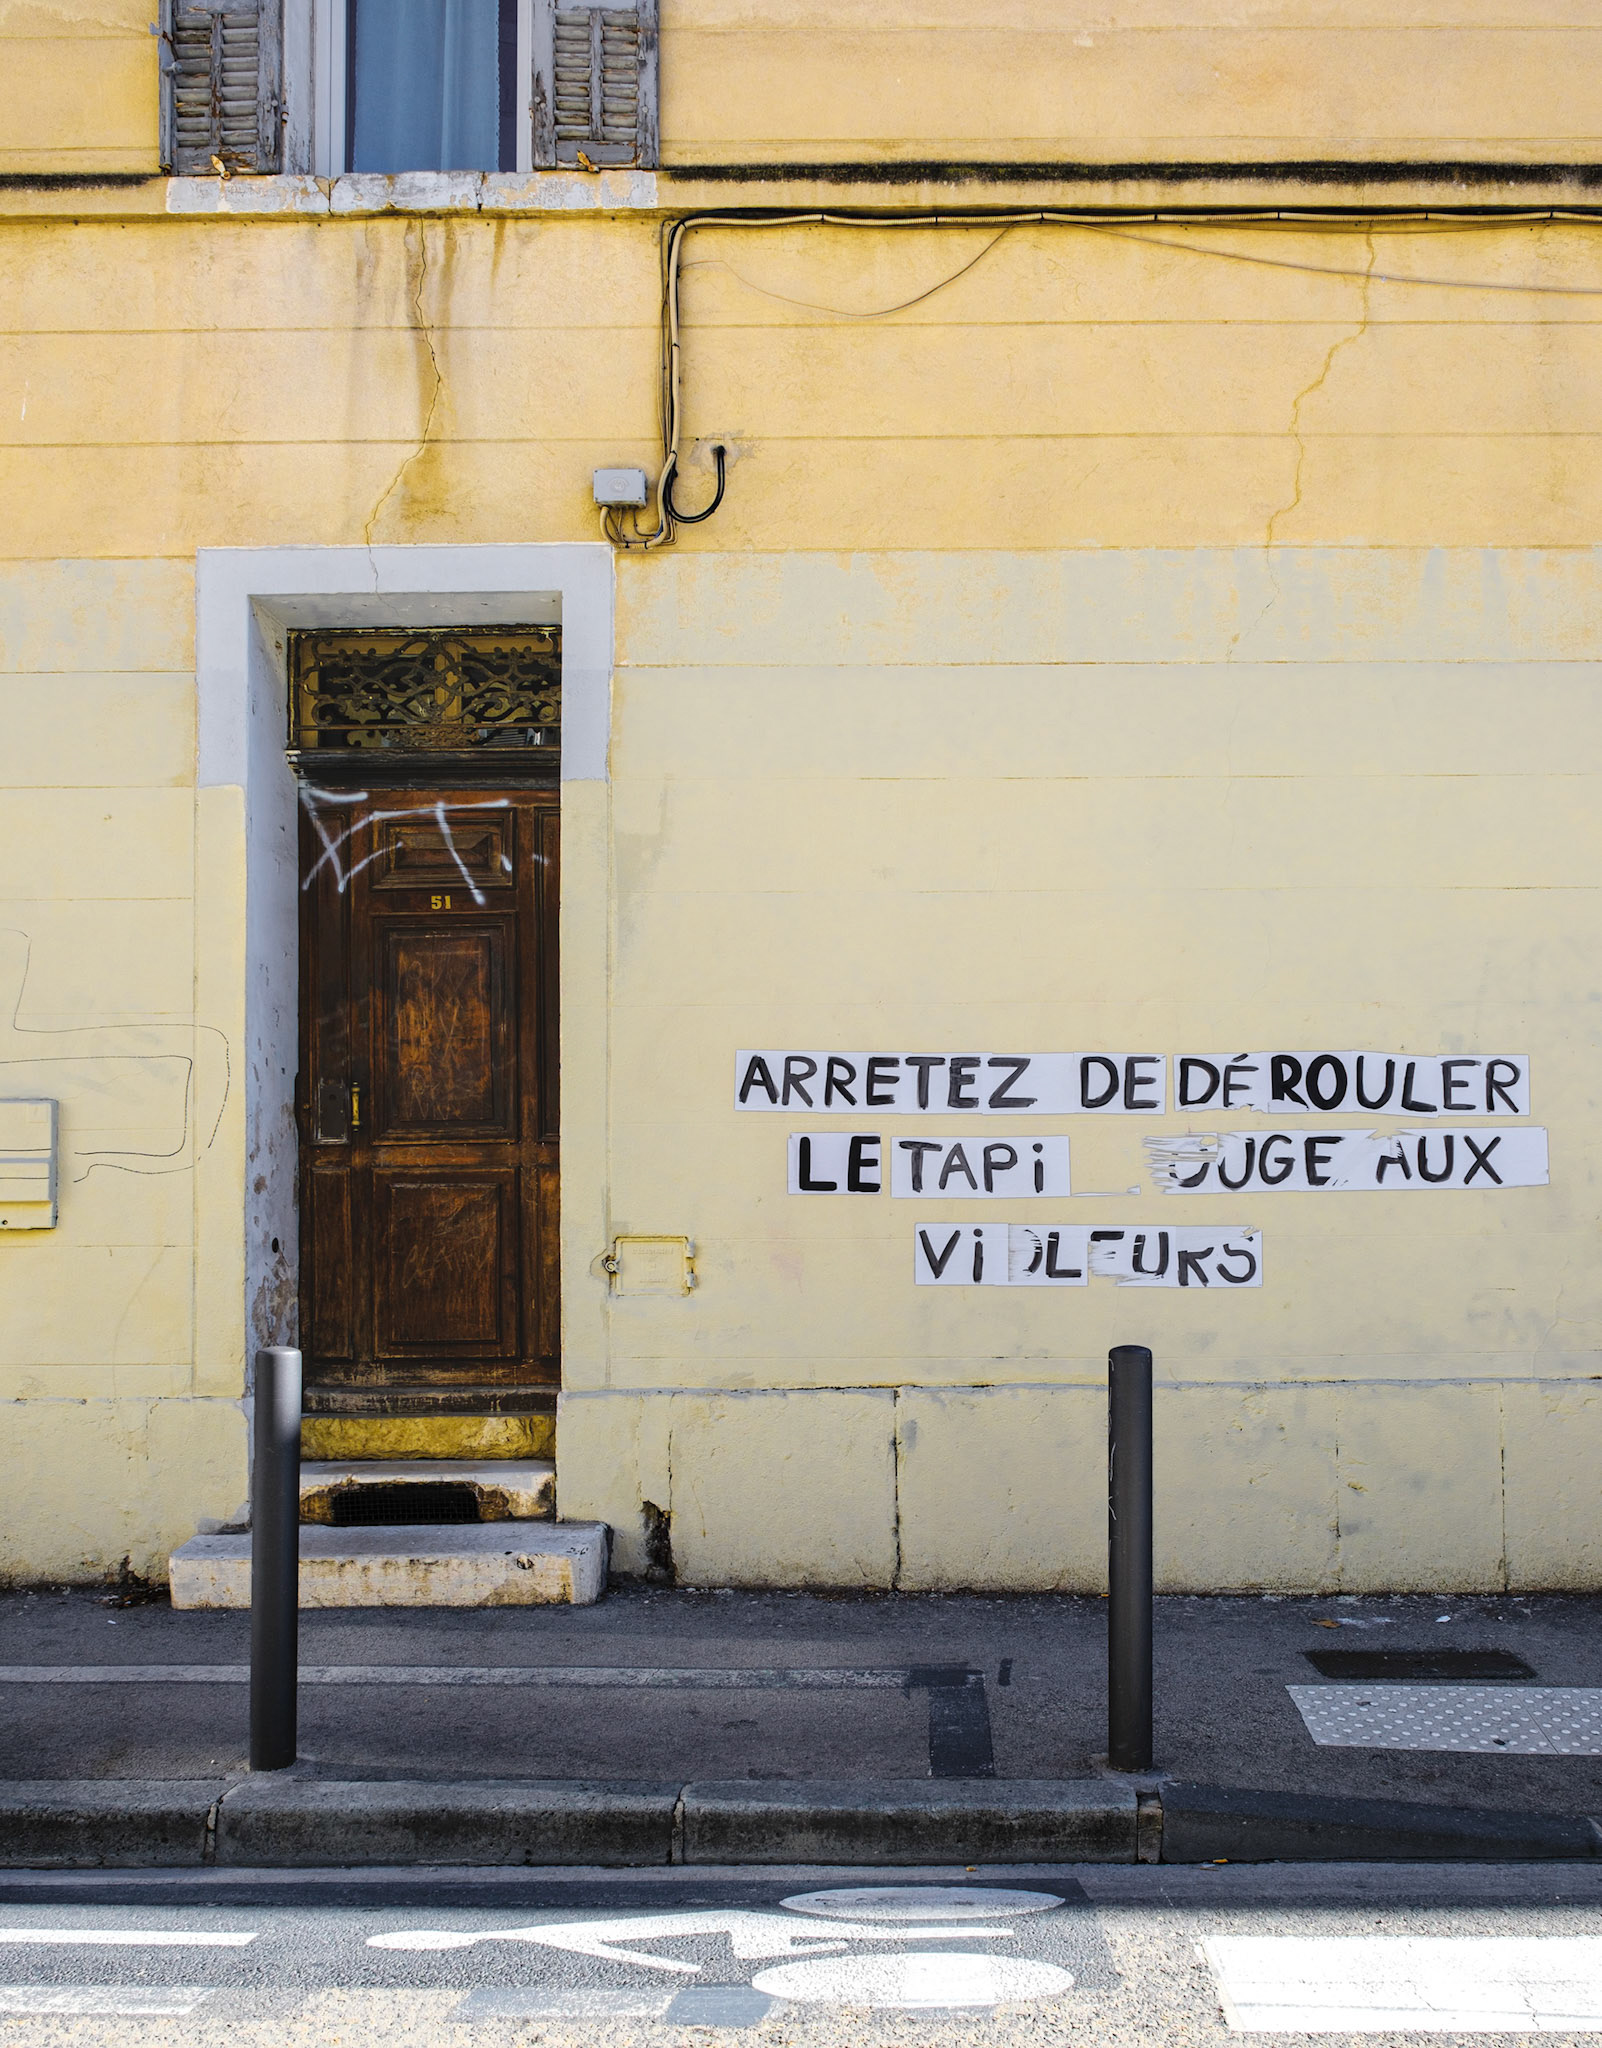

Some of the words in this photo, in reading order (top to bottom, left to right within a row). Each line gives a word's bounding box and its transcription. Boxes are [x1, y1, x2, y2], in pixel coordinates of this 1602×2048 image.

[431, 895, 451, 910] 51
[738, 1055, 1035, 1110] ARRETEZ
[1080, 1056, 1161, 1110] DE
[1178, 1053, 1520, 1114] DÉROULER
[798, 1135, 881, 1193] LE
